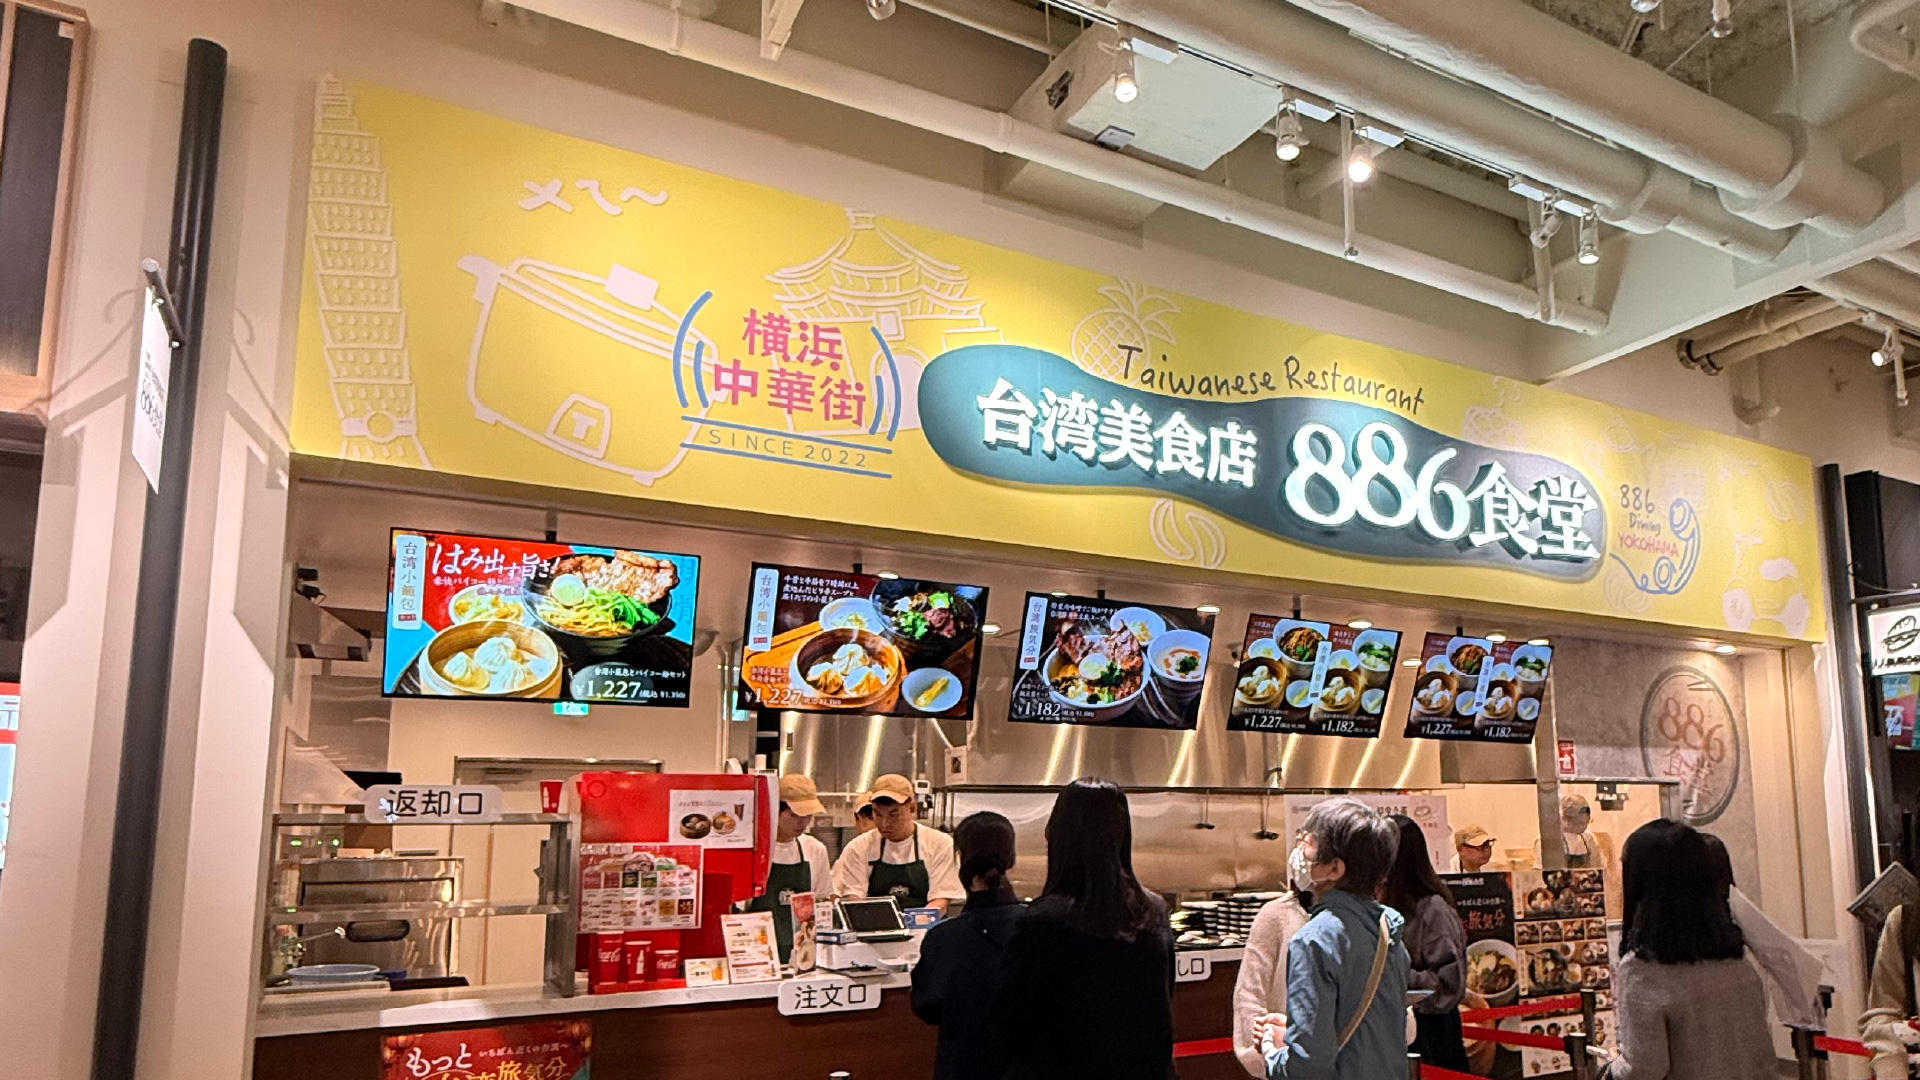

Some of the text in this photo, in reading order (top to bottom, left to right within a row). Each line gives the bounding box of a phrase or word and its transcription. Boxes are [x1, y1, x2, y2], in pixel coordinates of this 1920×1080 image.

[742, 308, 843, 371] 横浜
[714, 359, 867, 427] 中華街
[1118, 344, 1425, 415] Taiwanese Restaurant
[709, 429, 867, 467] SINCE 2022
[976, 376, 1601, 559] 台湾美食店 886食堂
[1619, 484, 1656, 514] 886
[1628, 512, 1662, 537] Dining
[1617, 532, 1679, 558] YOKOHAMA
[575, 680, 641, 698] ¥1,227
[745, 688, 803, 705] ¥1,227
[1018, 702, 1061, 716] ¥1,182
[1245, 715, 1282, 728] ¥1,227
[1321, 720, 1355, 732] ¥1,182
[1657, 697, 1726, 764] 886
[385, 789, 483, 817] 返却口
[794, 983, 867, 1010] 注文口
[406, 1043, 473, 1077] もっと
